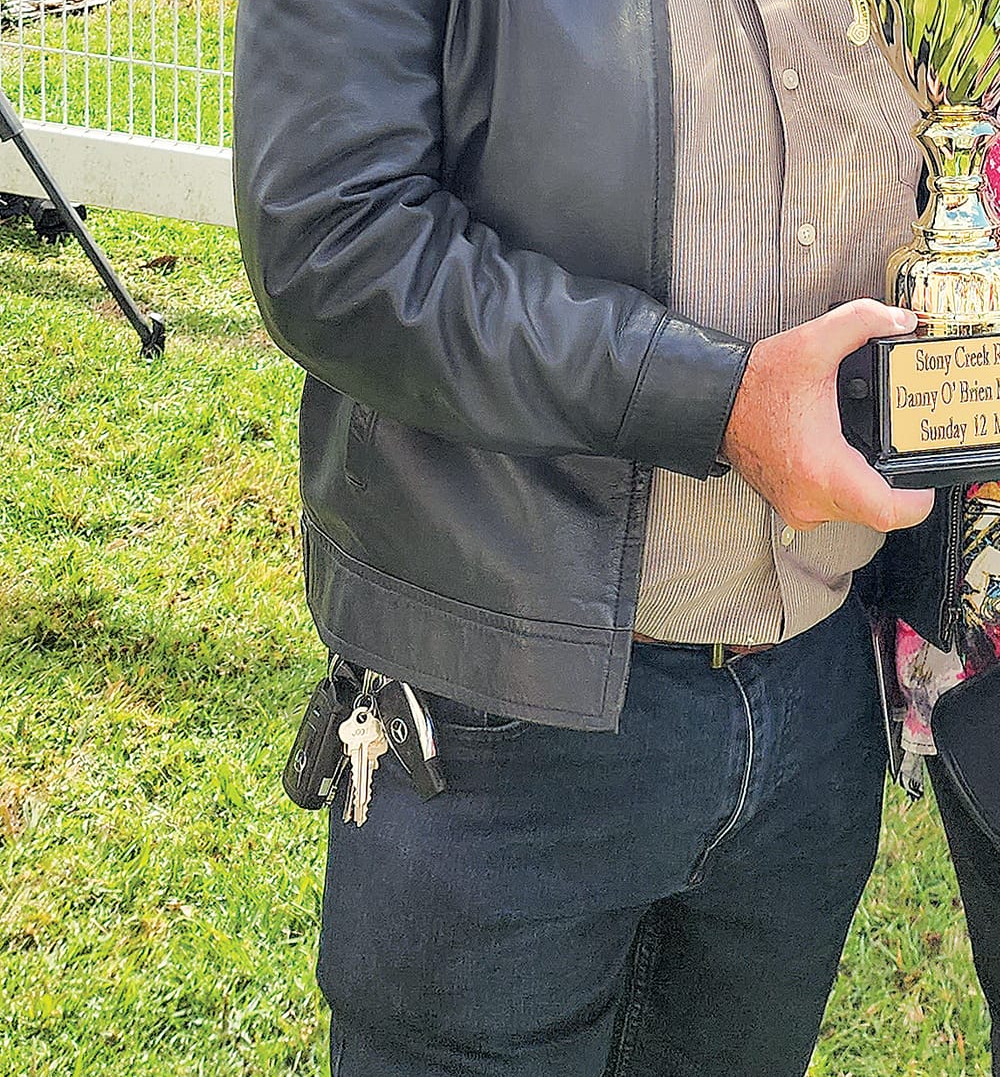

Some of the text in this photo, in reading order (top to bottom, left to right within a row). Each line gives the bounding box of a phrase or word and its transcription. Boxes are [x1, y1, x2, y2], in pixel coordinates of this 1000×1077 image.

[916, 349, 951, 375] Stony
[955, 344, 990, 368] Creek
[896, 386, 938, 412] Danny
[960, 380, 993, 403] Brien
[921, 416, 967, 444] Sunday
[974, 414, 987, 436] 12
